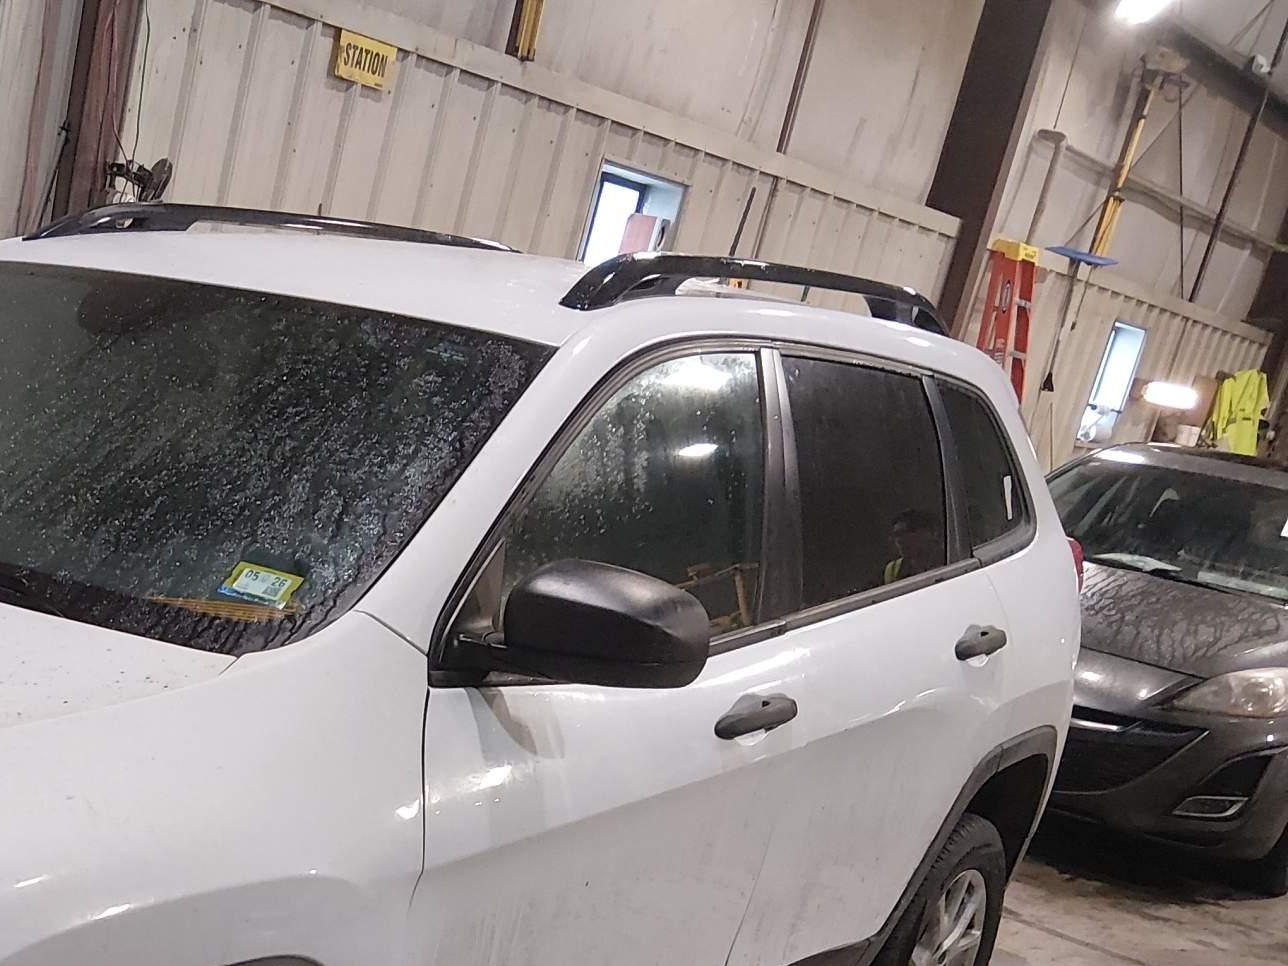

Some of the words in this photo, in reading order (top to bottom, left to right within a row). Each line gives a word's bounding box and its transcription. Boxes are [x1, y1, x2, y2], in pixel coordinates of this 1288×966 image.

[344, 42, 388, 78] STATION
[244, 569, 261, 582] 05
[271, 576, 288, 588] 26
